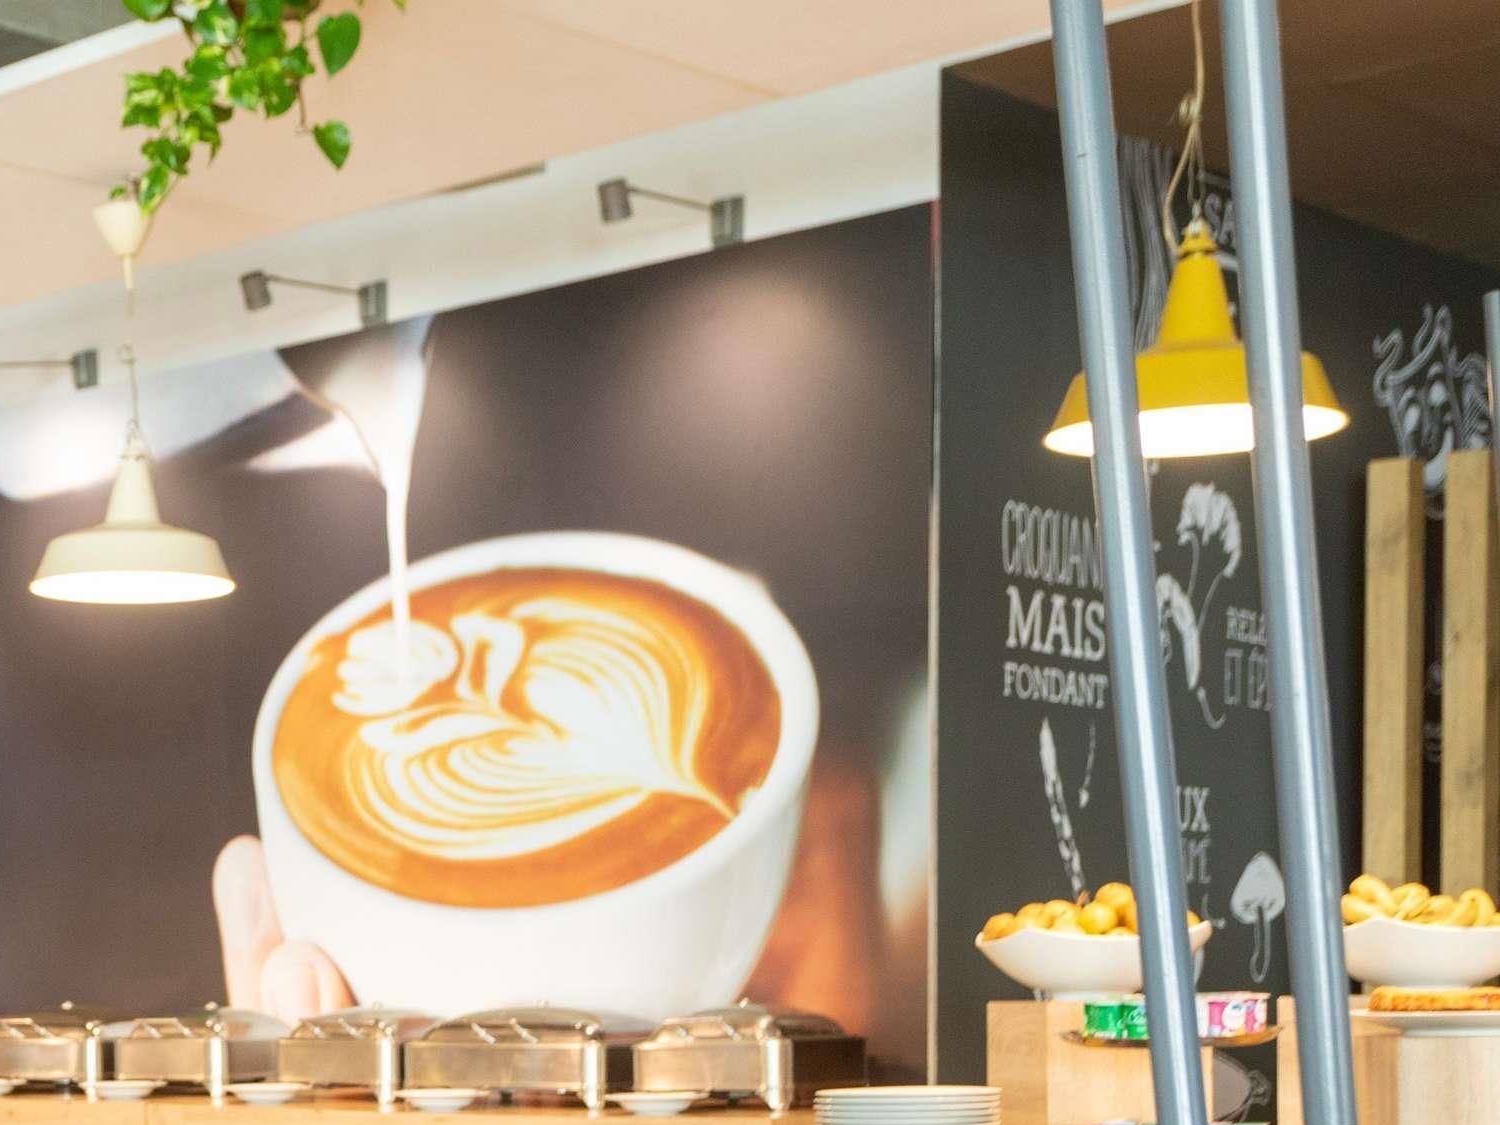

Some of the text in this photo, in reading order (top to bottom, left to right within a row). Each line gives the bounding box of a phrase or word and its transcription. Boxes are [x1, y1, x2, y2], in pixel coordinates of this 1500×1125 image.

[1001, 499, 1105, 589] CROQUAN
[1005, 584, 1106, 661] MAIS
[1002, 661, 1109, 709] FONDANT
